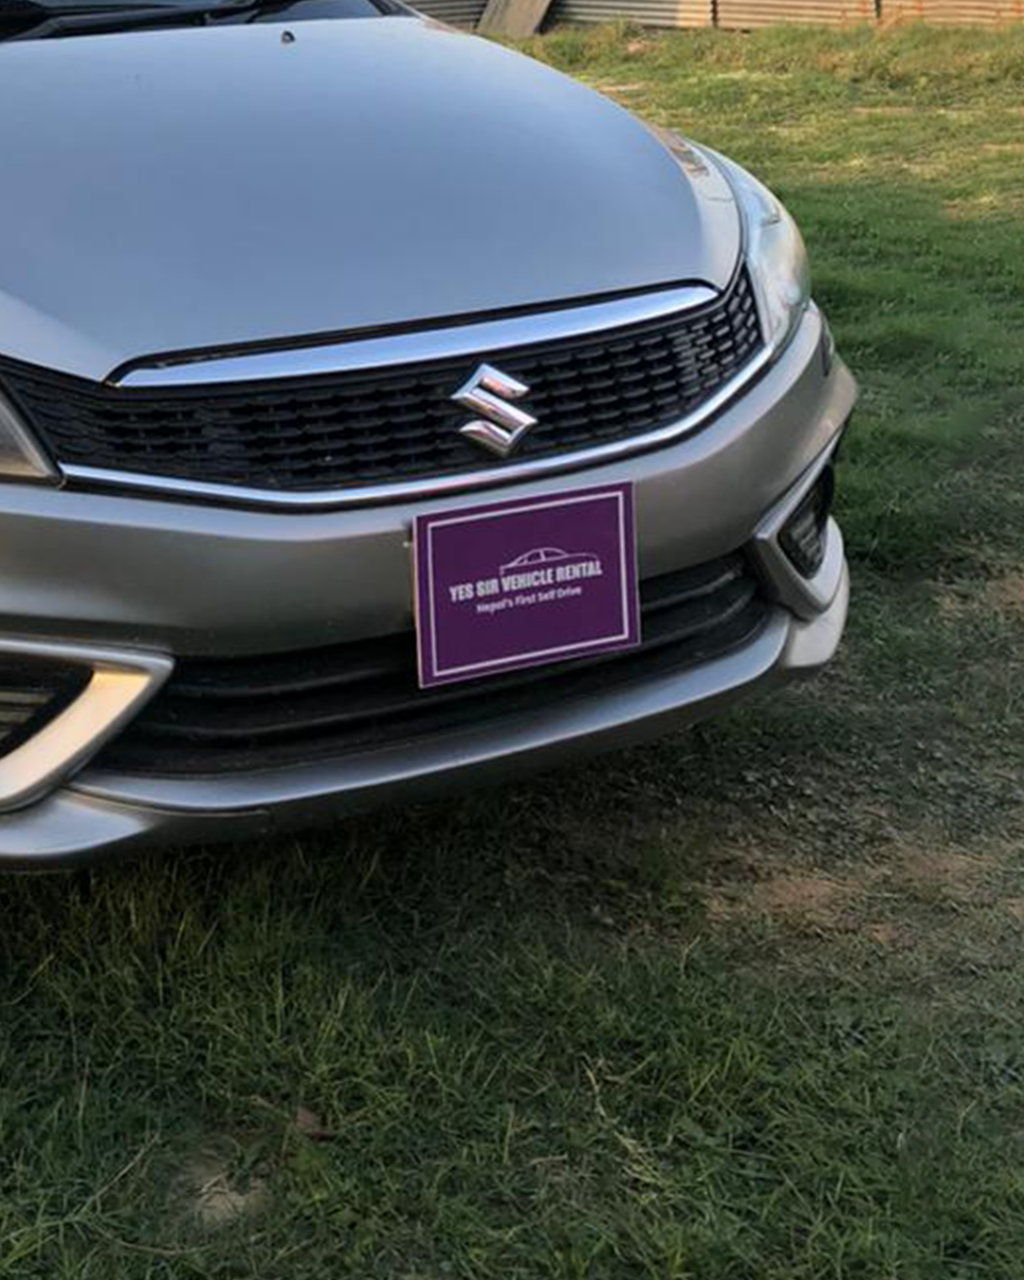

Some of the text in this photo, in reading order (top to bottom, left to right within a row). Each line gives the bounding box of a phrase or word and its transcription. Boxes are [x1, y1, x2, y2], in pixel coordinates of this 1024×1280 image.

[449, 560, 603, 602] YES SIR VEHICLE RENTAL
[515, 595, 536, 606] First
